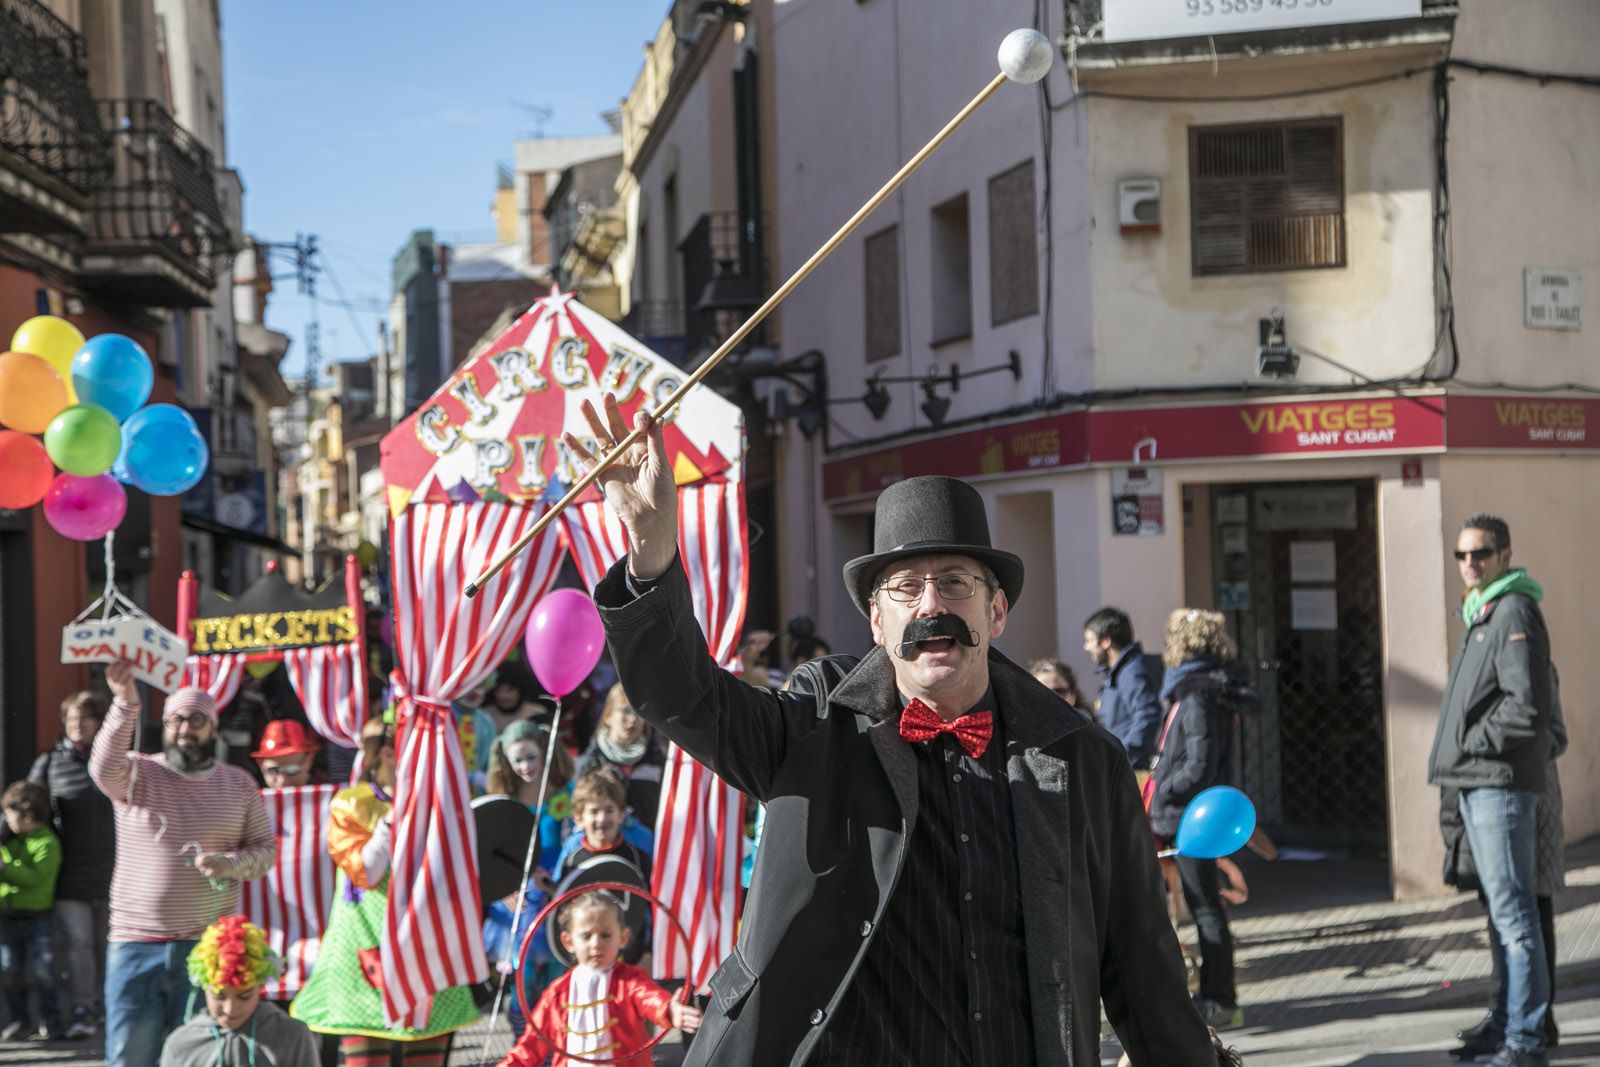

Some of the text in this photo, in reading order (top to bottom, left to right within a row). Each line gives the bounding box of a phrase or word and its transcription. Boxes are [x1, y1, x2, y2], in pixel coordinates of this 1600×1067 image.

[415, 335, 682, 456] CIRCUS
[1240, 404, 1396, 433] VIATGES
[1494, 401, 1585, 426] VIATGES
[1297, 428, 1396, 446] SANT CUGAT
[1528, 427, 1585, 440] SANT CUGAT
[74, 627, 115, 640] ON
[190, 606, 358, 651] TICKETS
